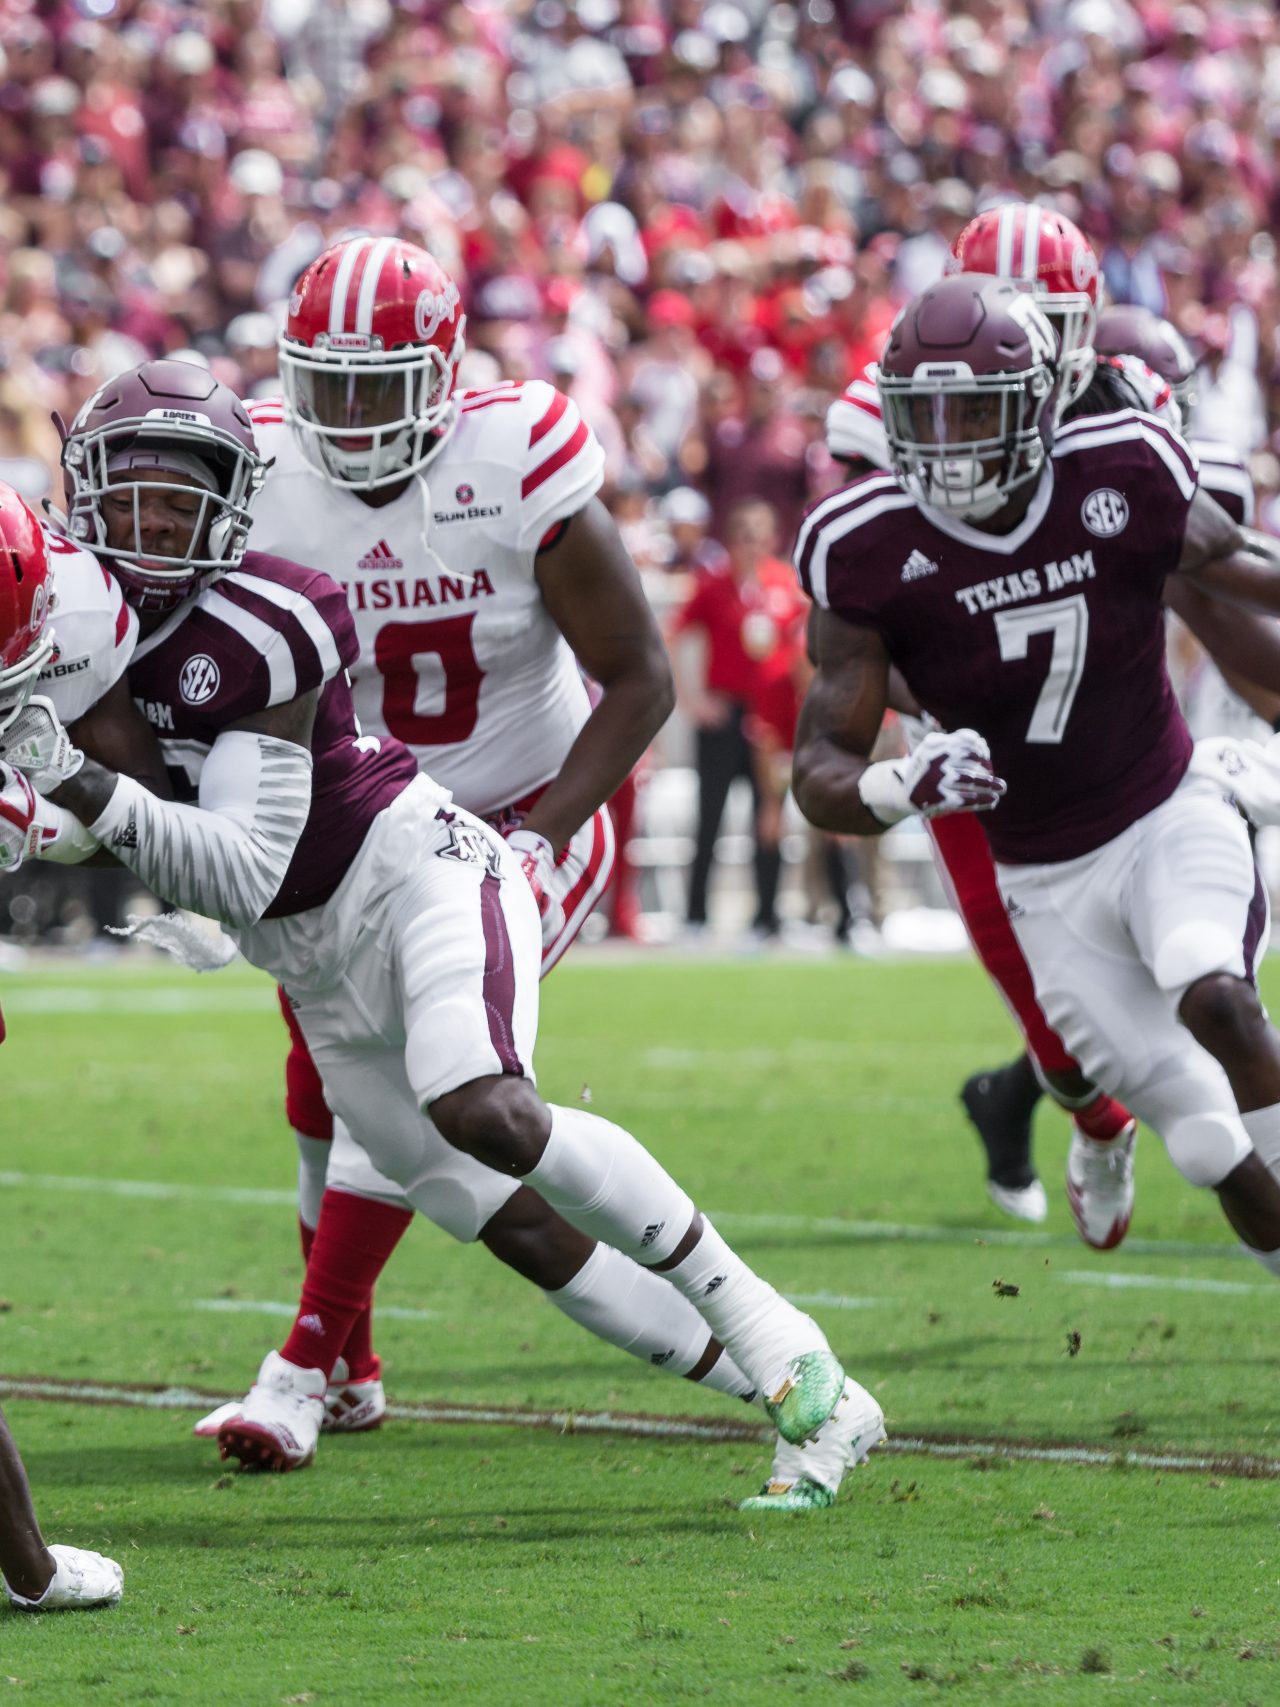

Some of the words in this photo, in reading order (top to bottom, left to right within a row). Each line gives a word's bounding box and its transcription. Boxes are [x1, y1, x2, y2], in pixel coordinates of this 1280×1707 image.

[433, 510, 468, 524] SUN
[468, 504, 504, 520] BELT
[1086, 491, 1125, 532] SEC
[341, 566, 496, 612] ISIANA
[954, 567, 1042, 616] TEXAS
[1042, 549, 1097, 592] A&M
[54, 657, 91, 679] BELT
[182, 657, 216, 702] SEC
[351, 610, 488, 746] 0
[992, 592, 1090, 745] 7
